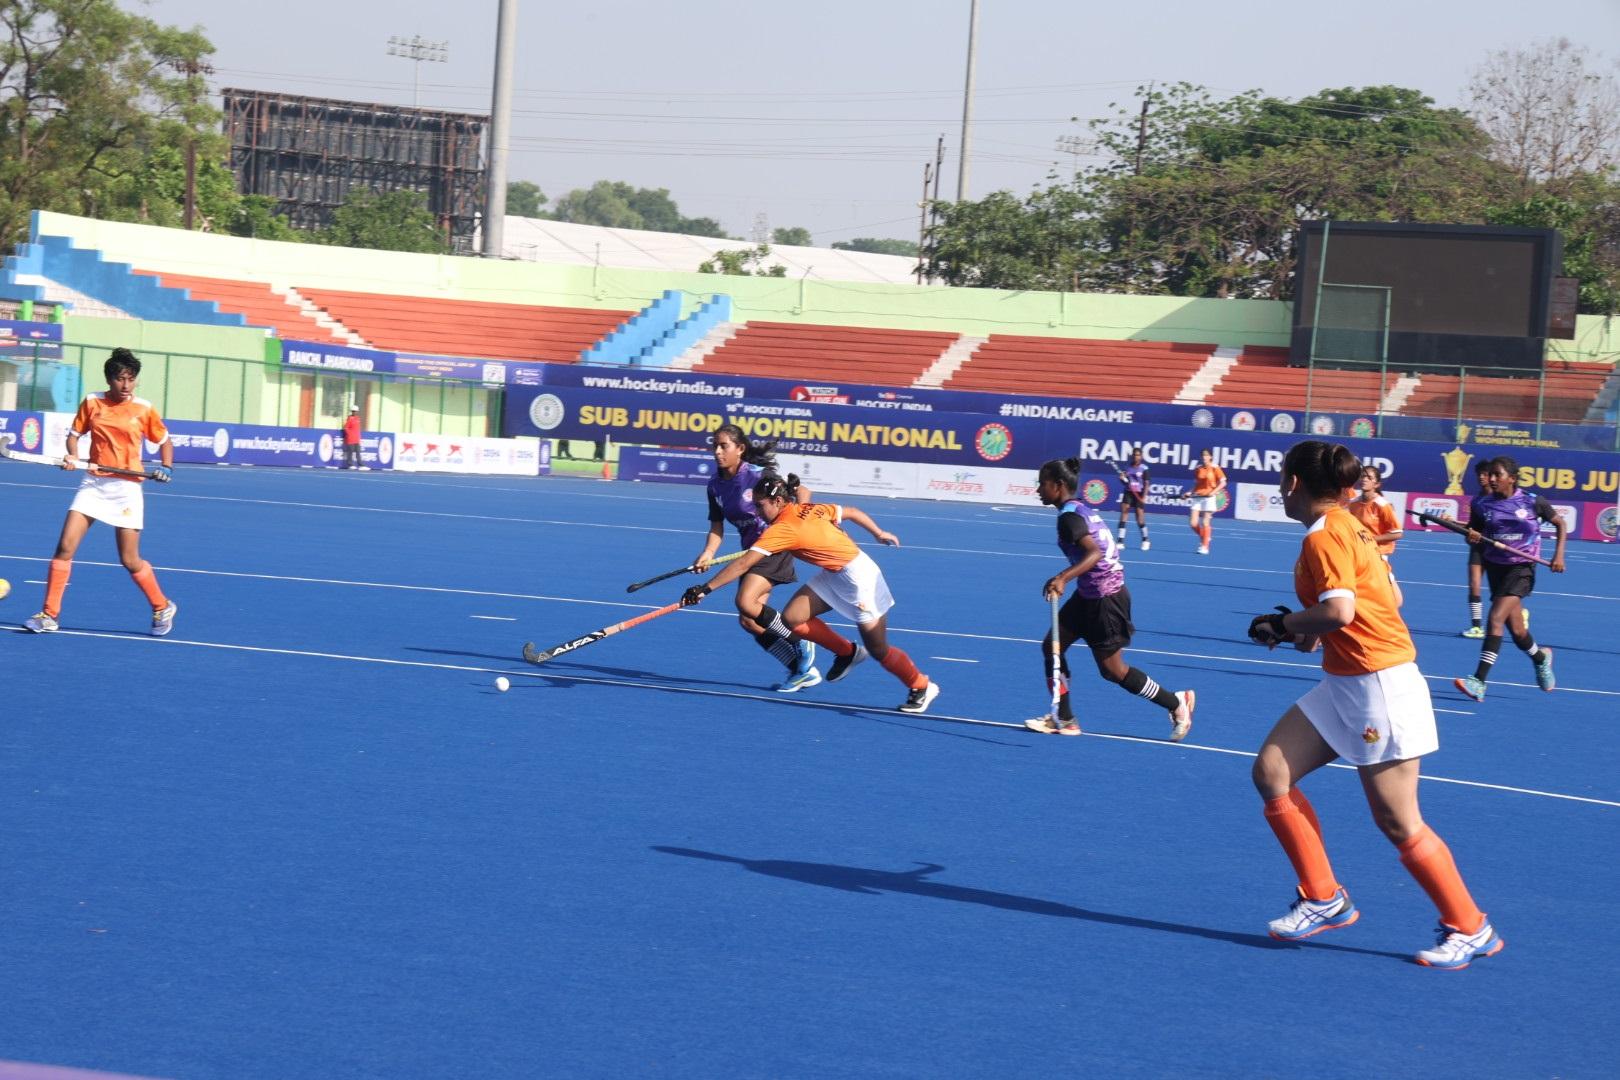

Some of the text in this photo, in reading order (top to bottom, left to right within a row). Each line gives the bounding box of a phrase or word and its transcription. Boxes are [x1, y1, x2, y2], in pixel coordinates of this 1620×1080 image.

[582, 375, 745, 399] www.hockeyindia.org
[744, 405, 783, 415] HOCKEY
[784, 408, 812, 417] INDIA
[902, 402, 933, 412] INDIA
[999, 403, 1135, 424] #INDIAKAGAME
[578, 405, 629, 427] SUB
[633, 409, 723, 433] JUNIOR
[729, 415, 827, 441] WOMEN
[831, 423, 962, 450] NATIONAL
[799, 443, 829, 453] 2026
[1079, 437, 1199, 470] RANCHI,
[1518, 466, 1577, 490] SUB
[552, 634, 594, 657] ALFA
